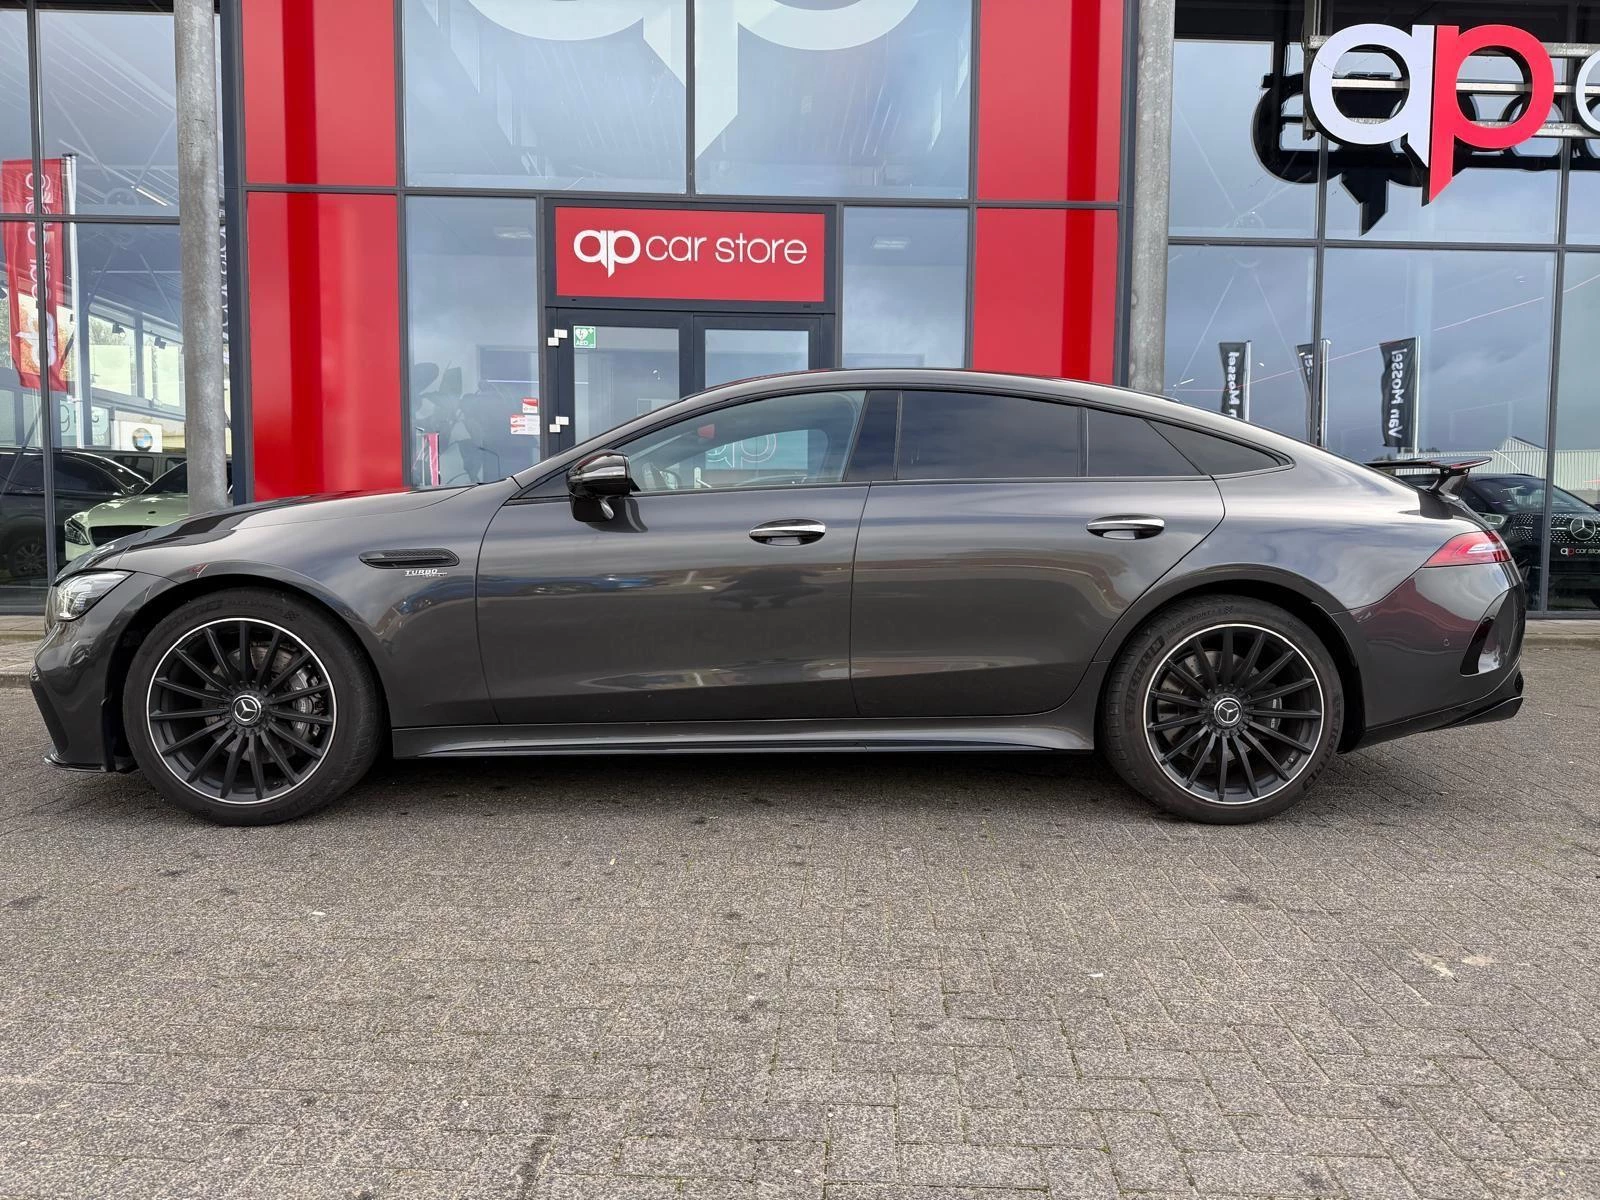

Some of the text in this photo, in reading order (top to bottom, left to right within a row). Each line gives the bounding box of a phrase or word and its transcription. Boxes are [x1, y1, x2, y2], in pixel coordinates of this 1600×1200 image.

[1309, 23, 1555, 204] ap
[573, 229, 808, 278] ap car store
[405, 568, 438, 577] TURBO
